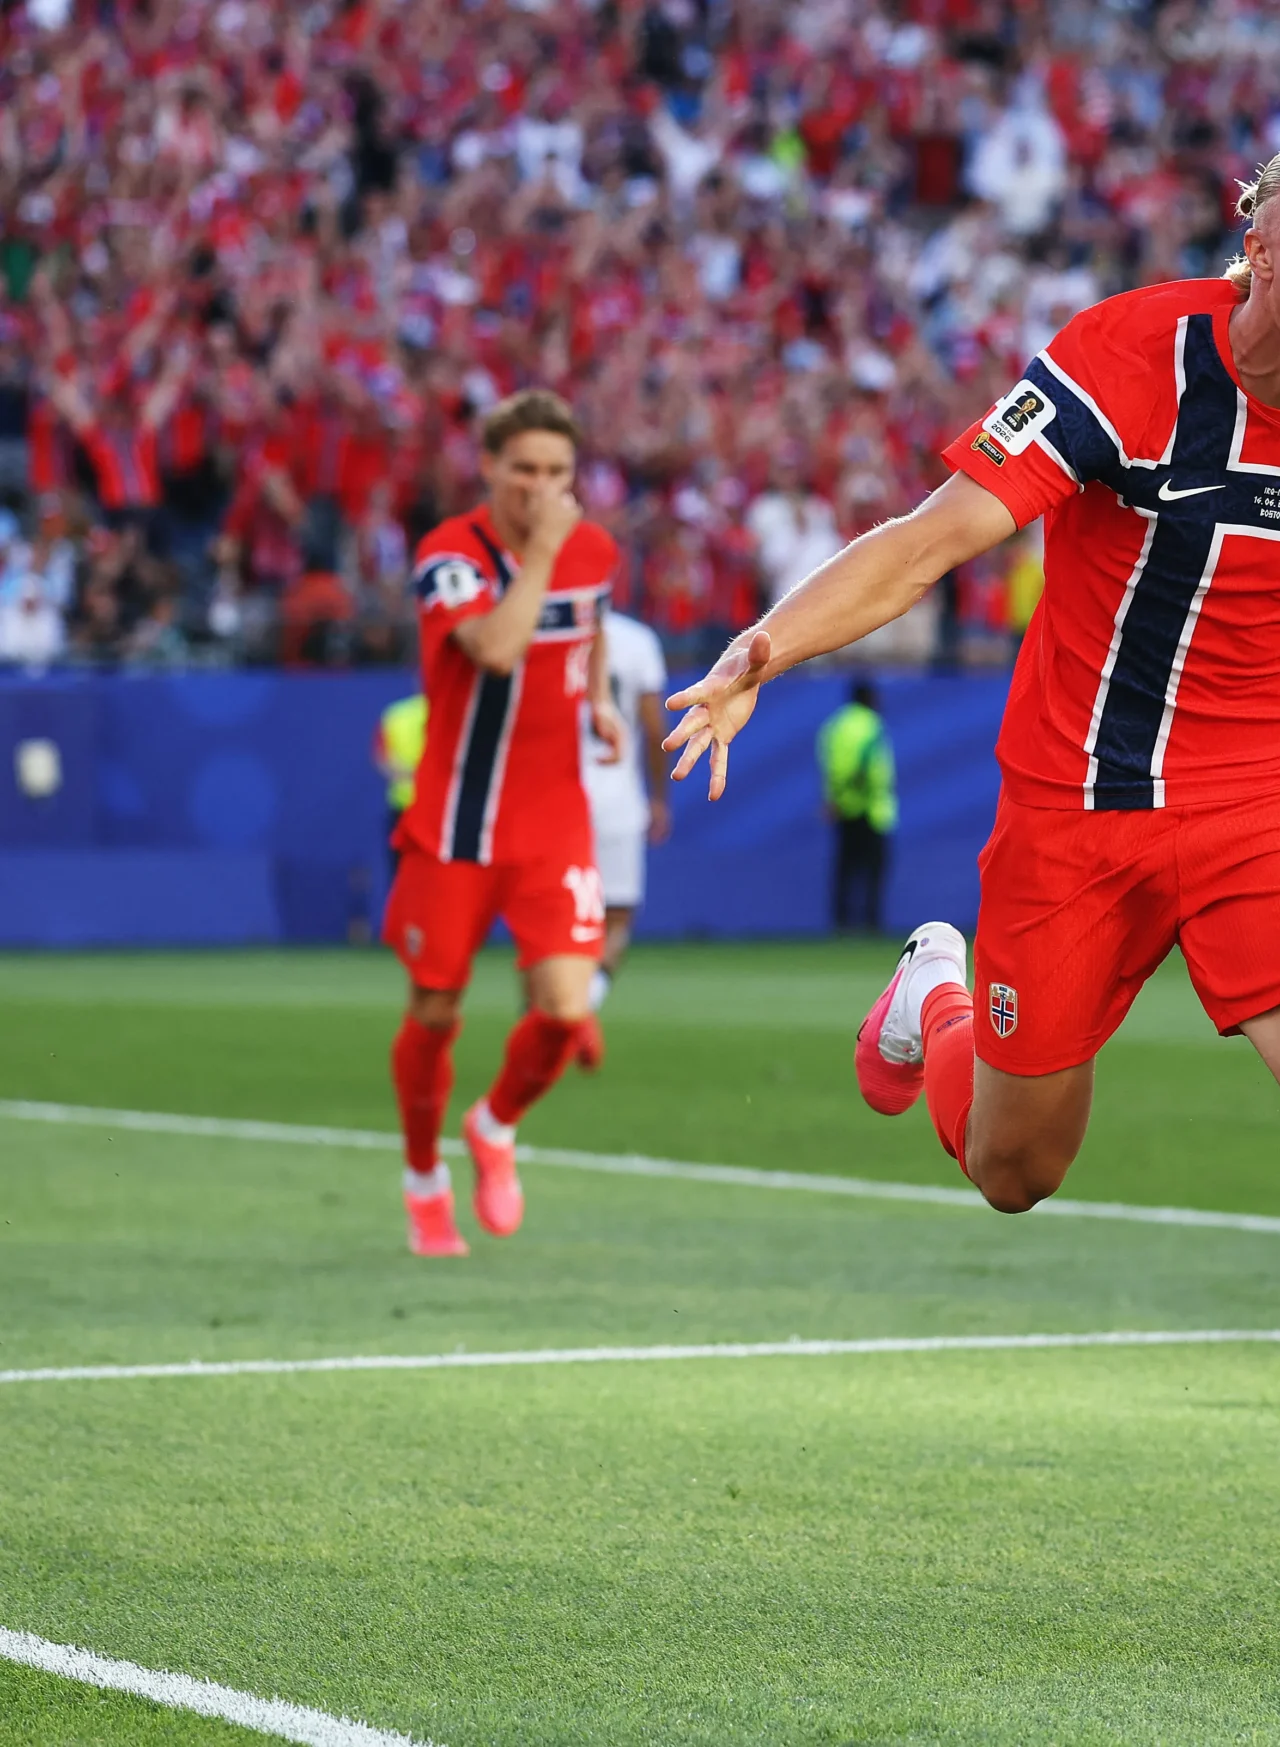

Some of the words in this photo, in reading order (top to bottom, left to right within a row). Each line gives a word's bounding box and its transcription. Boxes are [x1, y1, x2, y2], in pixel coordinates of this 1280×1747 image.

[1006, 416, 1018, 428] FIFA
[991, 424, 1011, 443] 2026
[982, 441, 1004, 460] DEBUT
